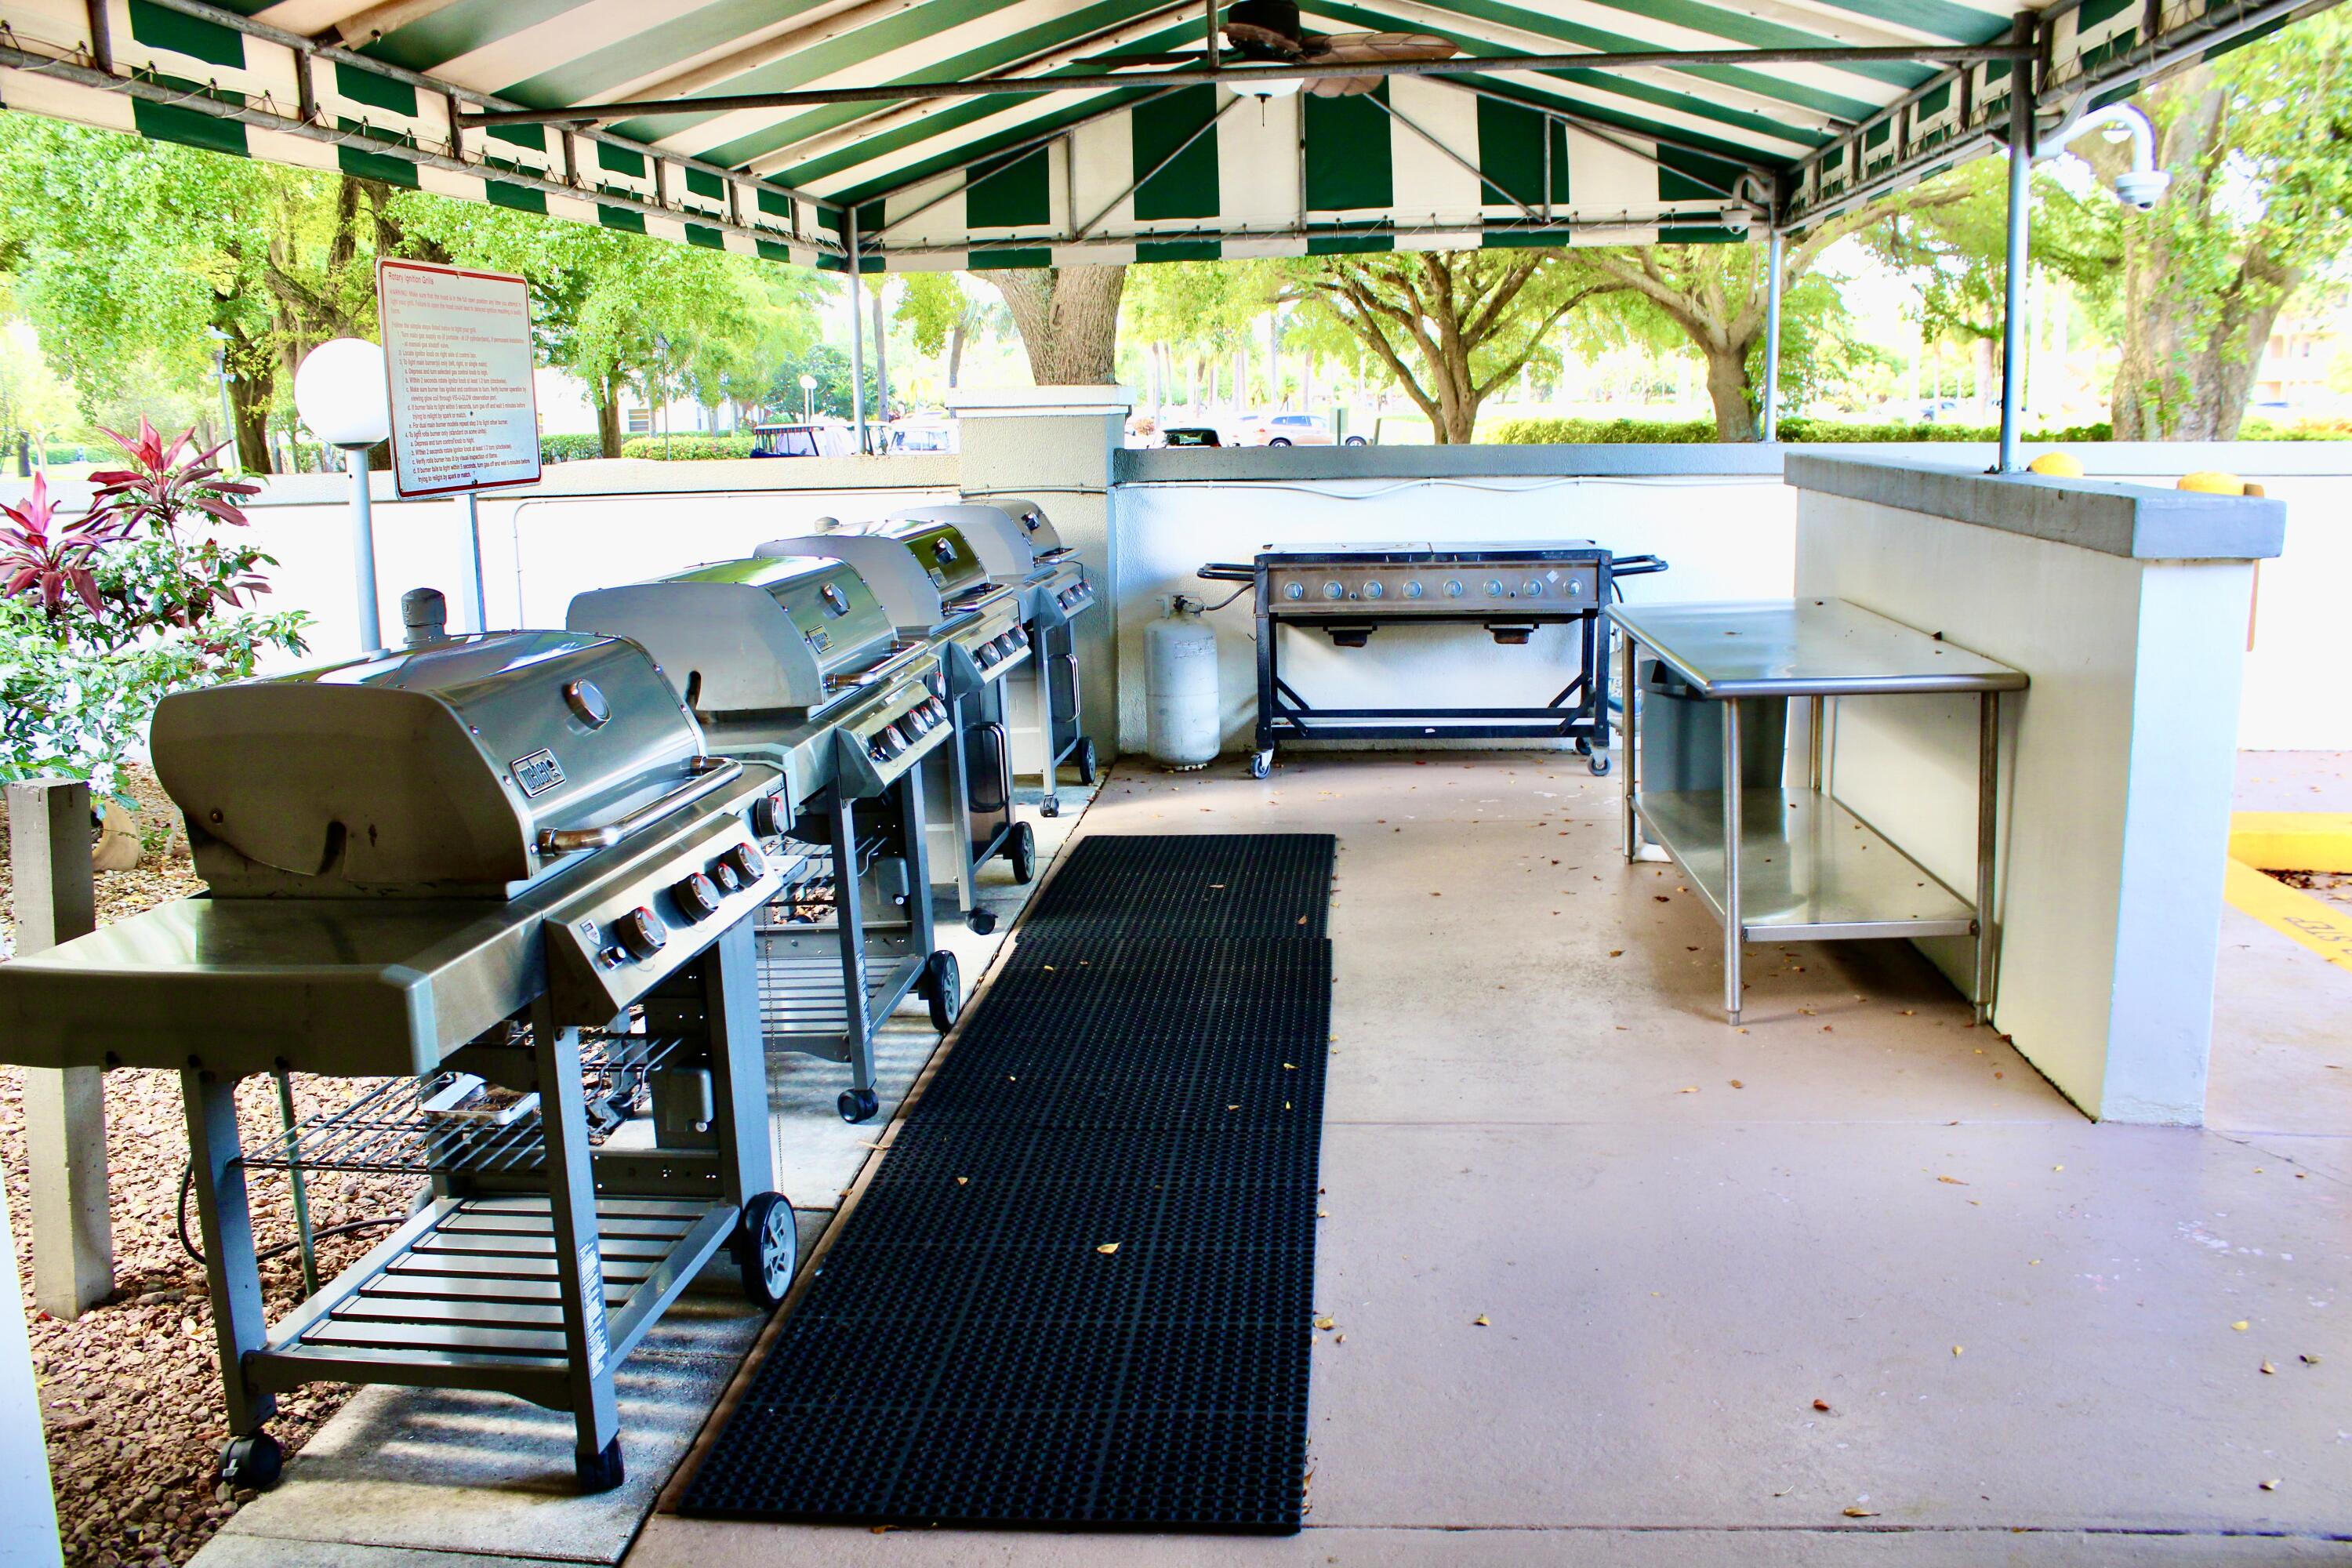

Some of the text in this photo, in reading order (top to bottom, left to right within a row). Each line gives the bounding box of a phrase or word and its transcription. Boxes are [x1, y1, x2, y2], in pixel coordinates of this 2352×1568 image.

[388, 272, 434, 285] Rotary Ignition Grills
[518, 758, 554, 789] weber
